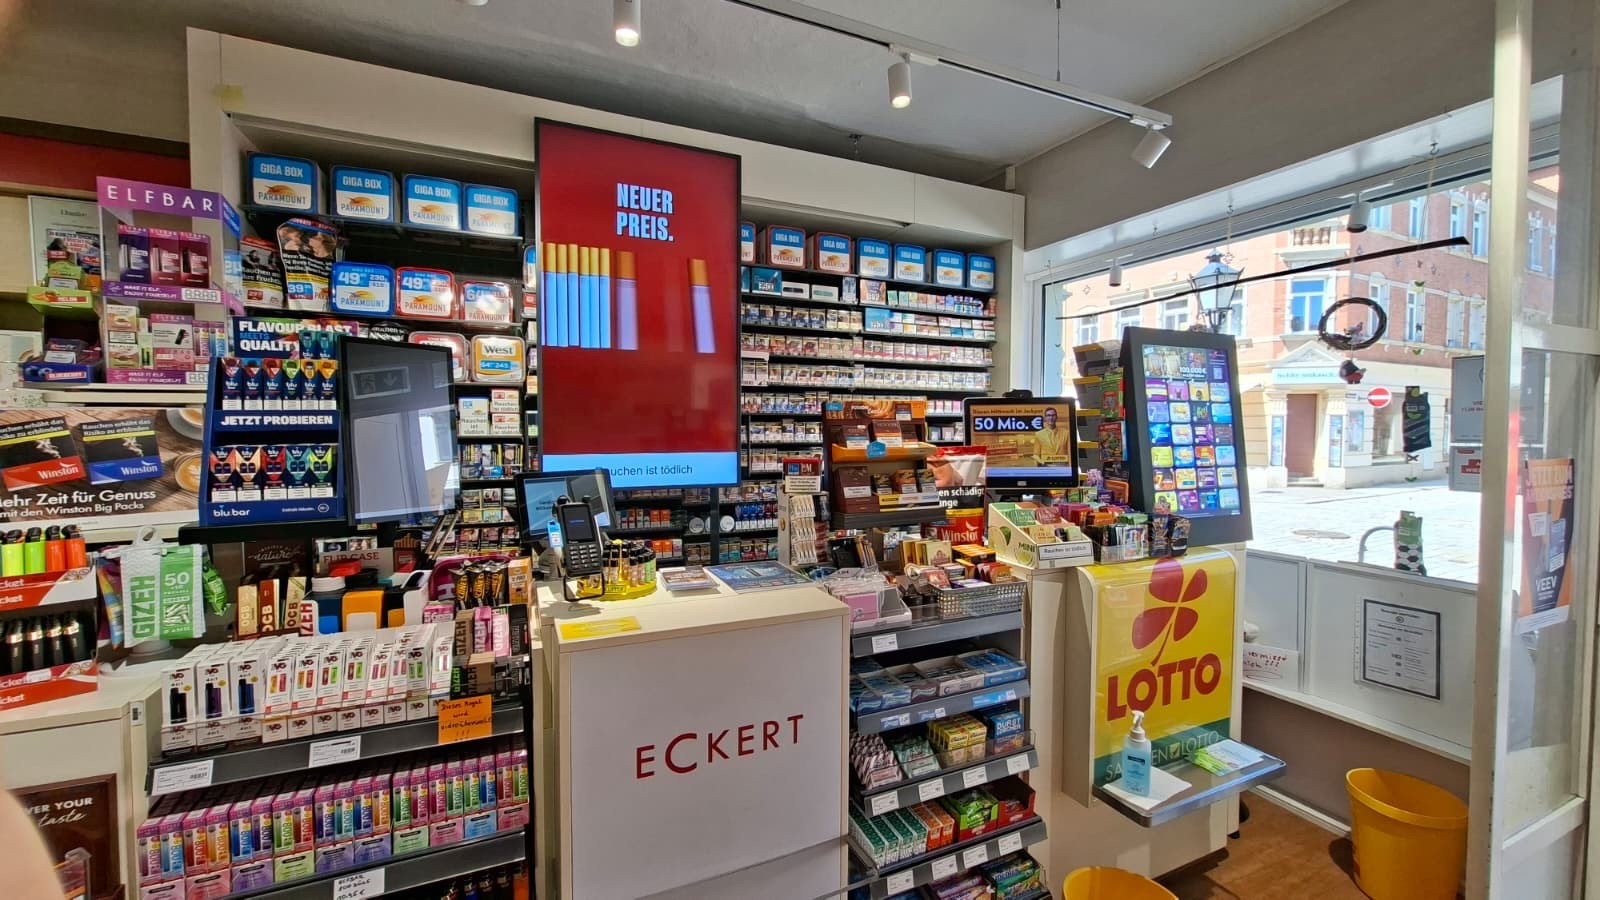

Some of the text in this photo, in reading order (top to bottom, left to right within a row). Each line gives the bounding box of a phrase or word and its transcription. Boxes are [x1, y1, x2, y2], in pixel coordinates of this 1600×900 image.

[260, 163, 304, 178] GIGA BOX
[342, 176, 382, 189] GIGA BOX
[107, 184, 212, 212] ELFBAR
[258, 192, 306, 204] PARAMOUNT
[414, 184, 452, 198] GIGA BOX
[473, 194, 509, 206] GIGA BOX
[617, 183, 673, 214] NEUER
[340, 203, 384, 215] PARAMOUNT
[413, 210, 454, 222] PARAMOUNT
[616, 210, 674, 242] PREIS.
[340, 297, 384, 308] PARAMOUNT
[404, 302, 446, 313] PARAMOUNT
[240, 340, 300, 351] QUALITY
[484, 345, 513, 355] West
[221, 415, 333, 426] JETZT PROBIEREN
[974, 417, 1042, 430] 50 Mio. €
[38, 466, 79, 480] Winston
[121, 465, 158, 476] Winston
[646, 466, 657, 476] ist
[661, 465, 693, 475] tödlich
[36, 493, 69, 505] Zeit
[72, 490, 96, 503] für
[99, 490, 156, 501] Genuss
[951, 486, 985, 498] schädigt
[0, 501, 144, 518] mit den Winston Big Packs
[350, 552, 379, 561] CASE
[164, 572, 190, 586] 50
[1536, 576, 1557, 592] VEEV
[130, 576, 155, 638] GIZEH
[240, 605, 250, 627] OCB
[262, 604, 273, 632] OCB
[287, 602, 298, 627] OCB
[300, 602, 313, 636] IZEH
[455, 621, 466, 656] GIZEH
[1107, 652, 1222, 722] LOTTO
[636, 714, 804, 779] ECKERT
[1180, 730, 1220, 756] LOTTO
[54, 797, 93, 810] YOUR
[38, 809, 87, 828] taste
